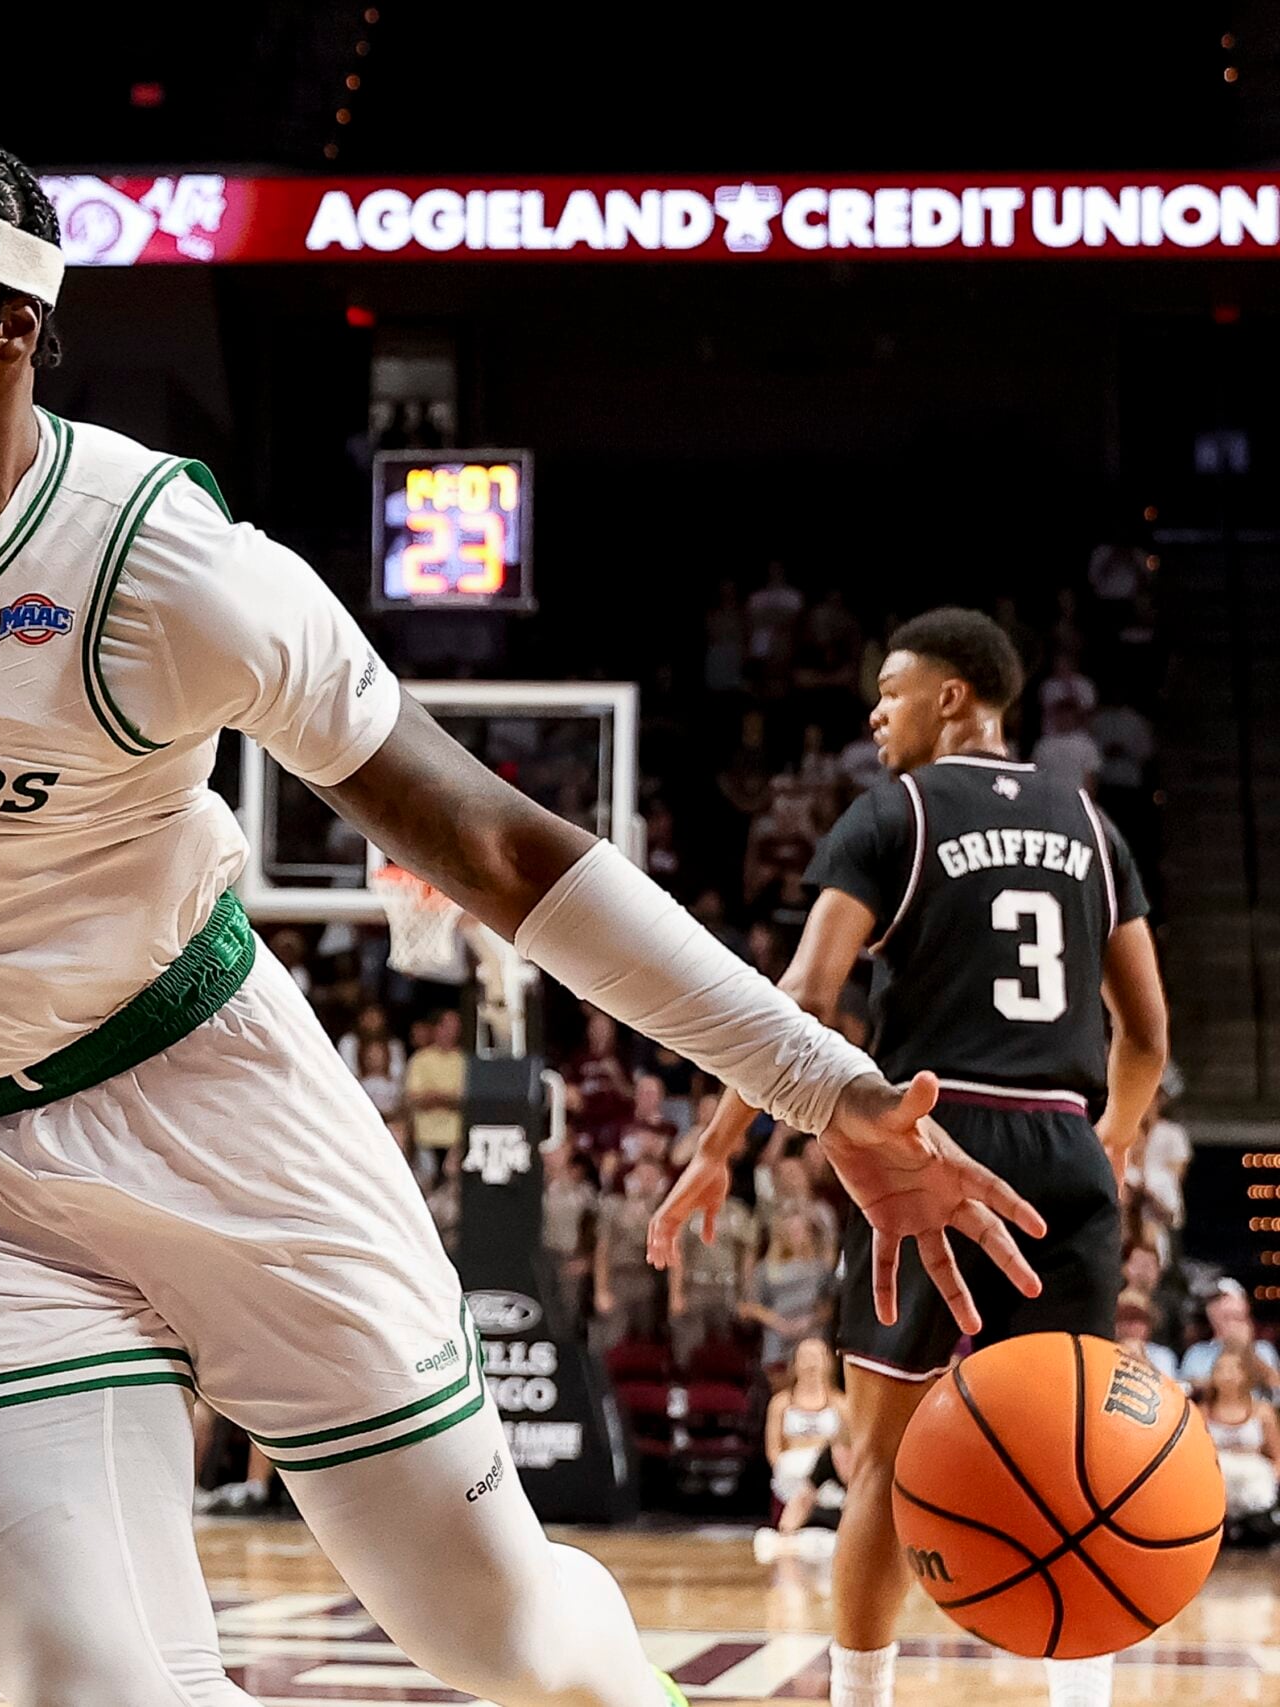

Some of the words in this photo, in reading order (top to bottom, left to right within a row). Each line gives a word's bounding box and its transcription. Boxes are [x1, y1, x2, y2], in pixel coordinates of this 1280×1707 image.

[306, 188, 715, 252] AGGIELAND
[781, 186, 1024, 249] CREDIT
[1032, 184, 1280, 248] UNION
[402, 512, 504, 594] 23
[937, 828, 1093, 882] GRIFFEN
[991, 888, 1068, 1022] 3
[416, 1340, 458, 1373] capelli
